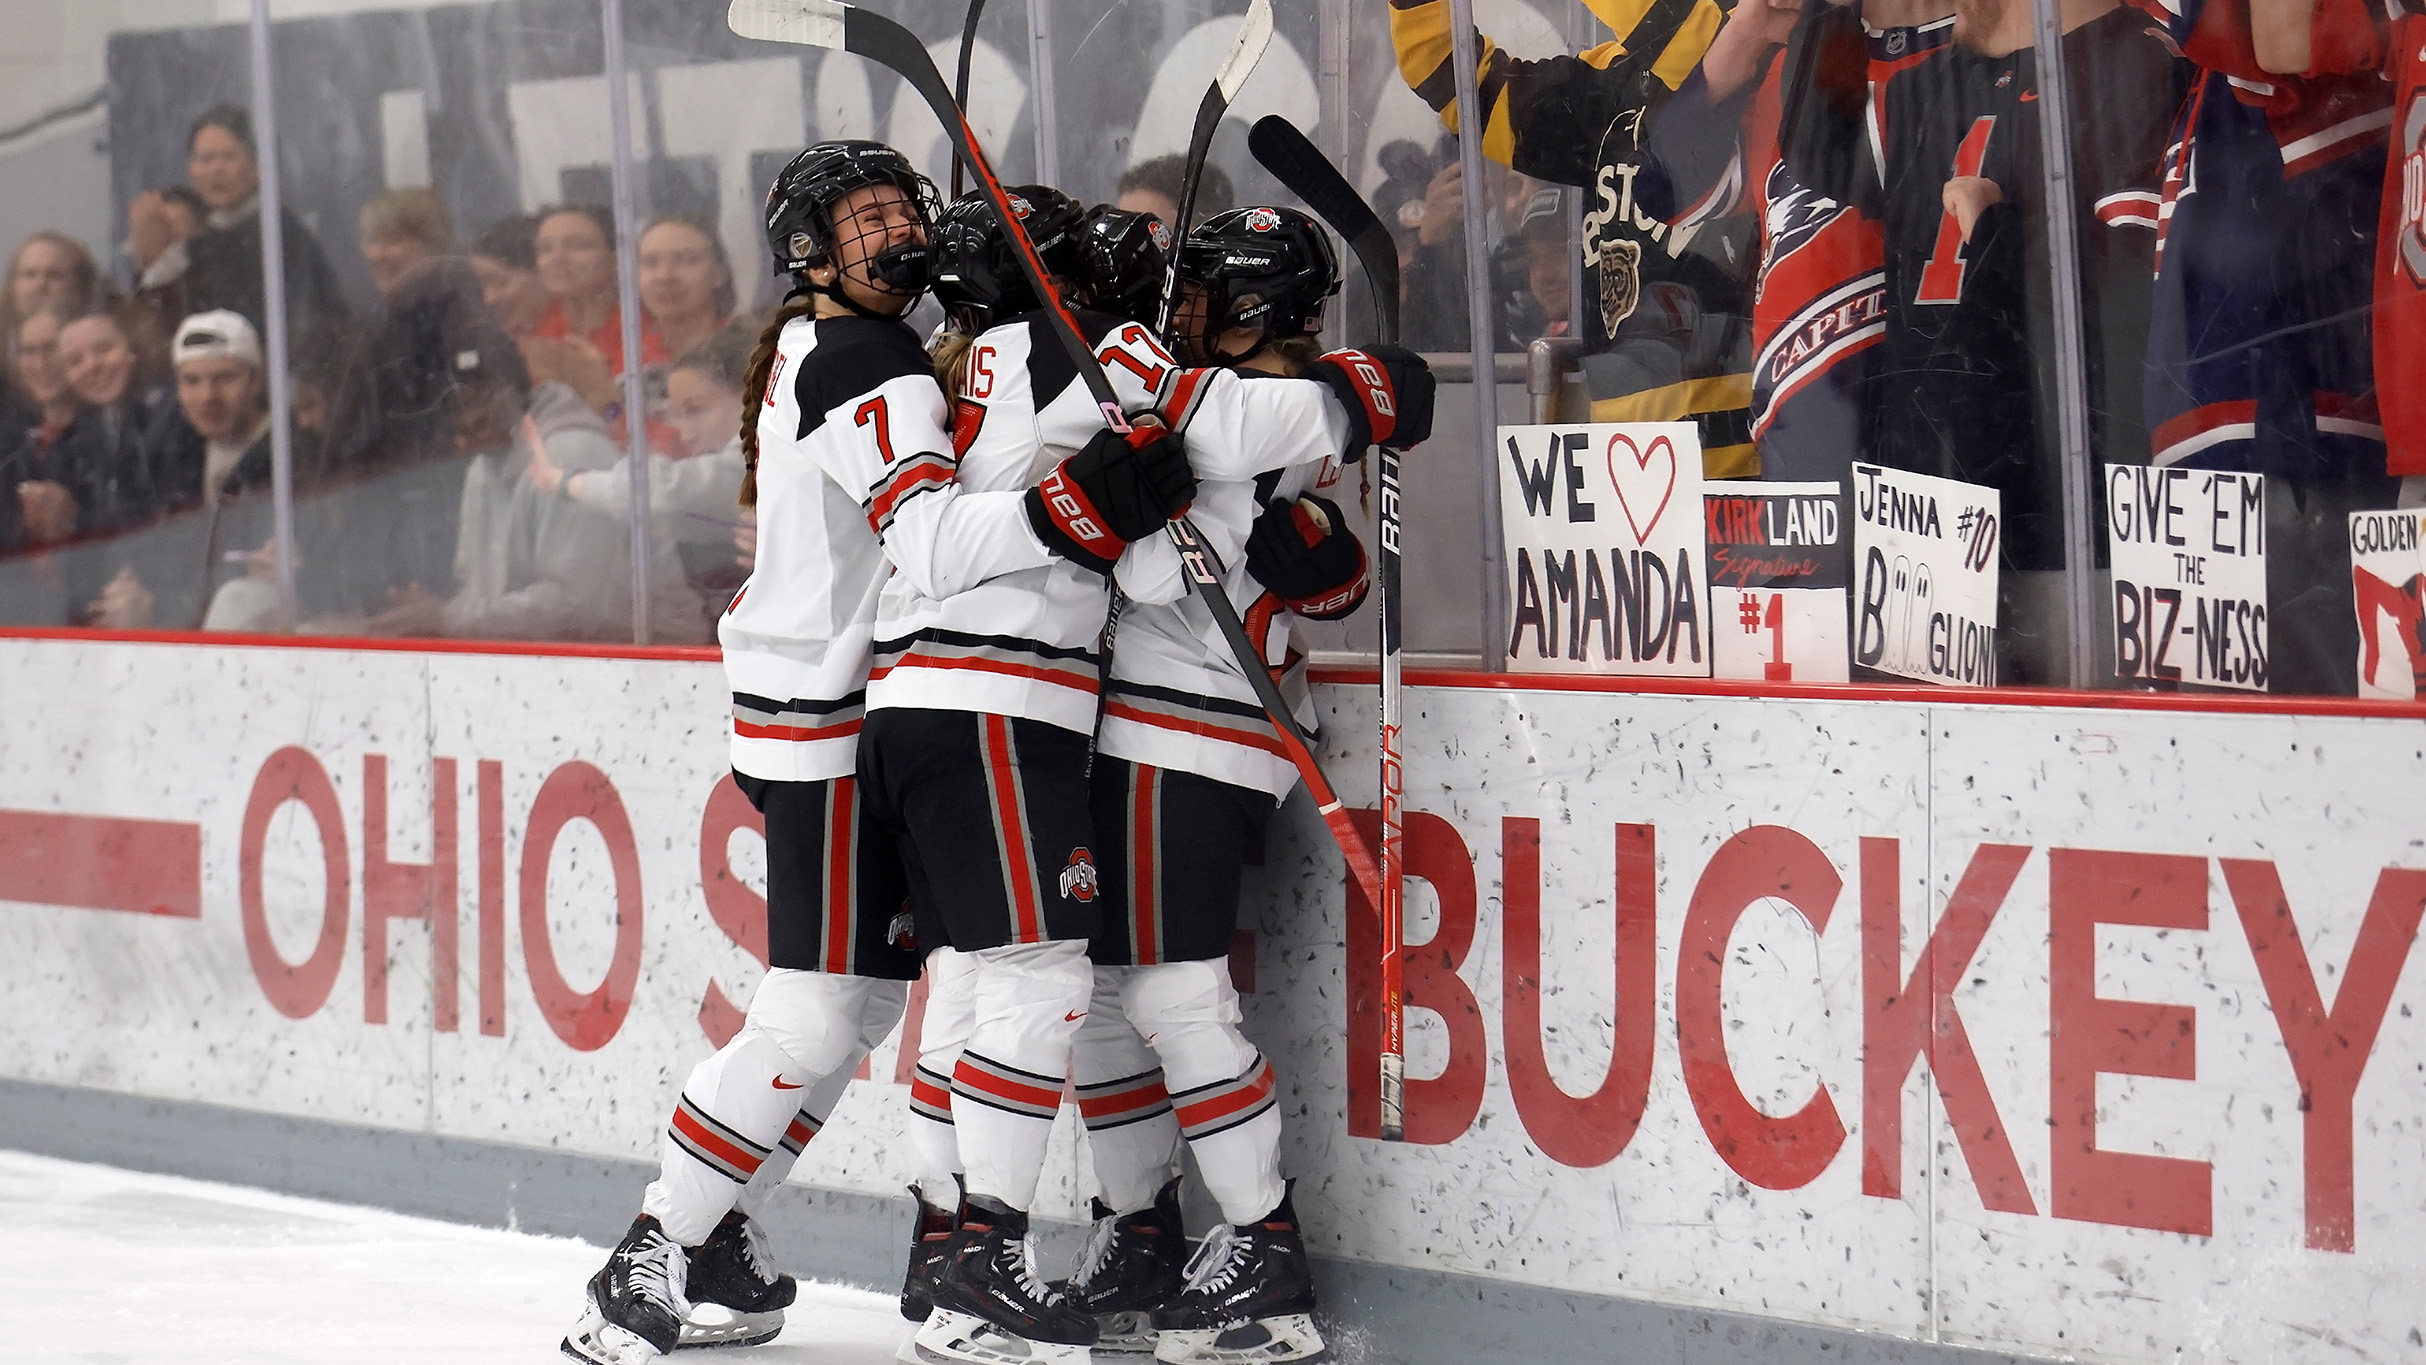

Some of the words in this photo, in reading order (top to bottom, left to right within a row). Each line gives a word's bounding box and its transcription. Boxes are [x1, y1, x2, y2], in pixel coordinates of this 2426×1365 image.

[1225, 256, 1271, 265] BAUER
[1771, 289, 1888, 383] CAPIT
[853, 394, 895, 466] 7
[1507, 432, 1596, 524] WE
[1704, 498, 1839, 546] KIRKLAND
[1856, 466, 1942, 540] JENNA
[1957, 504, 1998, 574] #10
[2110, 466, 2189, 547] GIVE
[2201, 473, 2263, 558] 'EM
[2173, 553, 2206, 586] THE
[2352, 514, 2417, 556] GOLDEN
[1508, 547, 1702, 664] AMANDA
[1738, 593, 1792, 681] #1
[2114, 580, 2269, 688] BIZ-NESS
[239, 744, 643, 1052] OHIO
[1345, 806, 2426, 1254] BUCKEY
[991, 1288, 1025, 1313] BAUER
